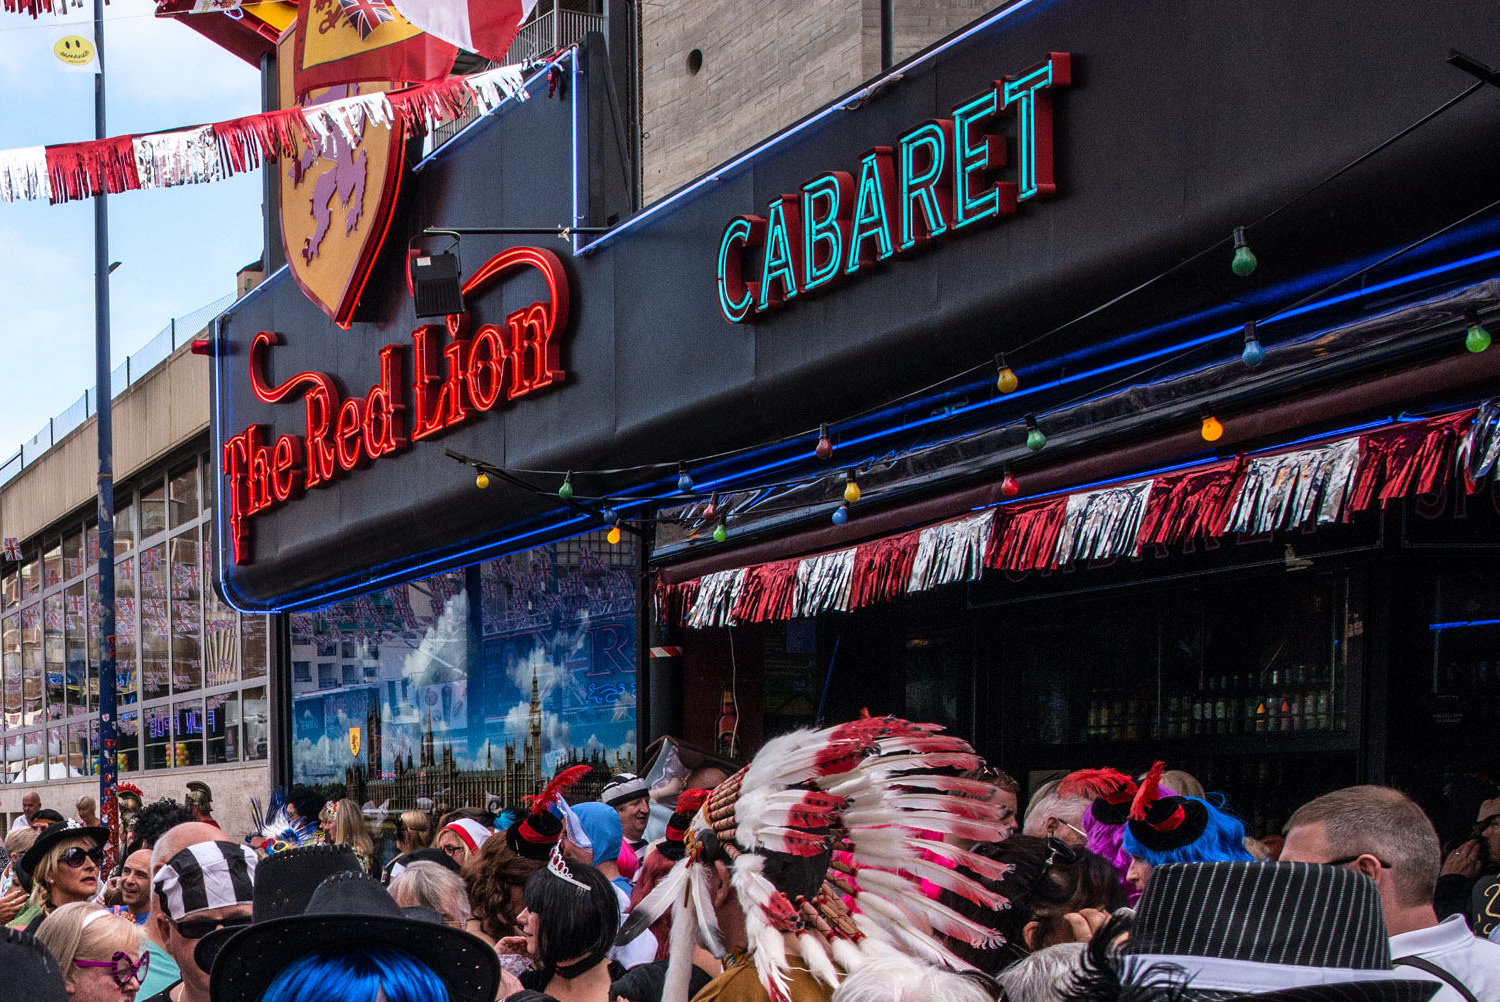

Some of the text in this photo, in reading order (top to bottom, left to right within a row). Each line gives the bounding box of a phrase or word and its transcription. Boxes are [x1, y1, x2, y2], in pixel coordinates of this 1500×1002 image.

[717, 51, 1071, 325] CABARET
[224, 246, 570, 565] The Red Lion
